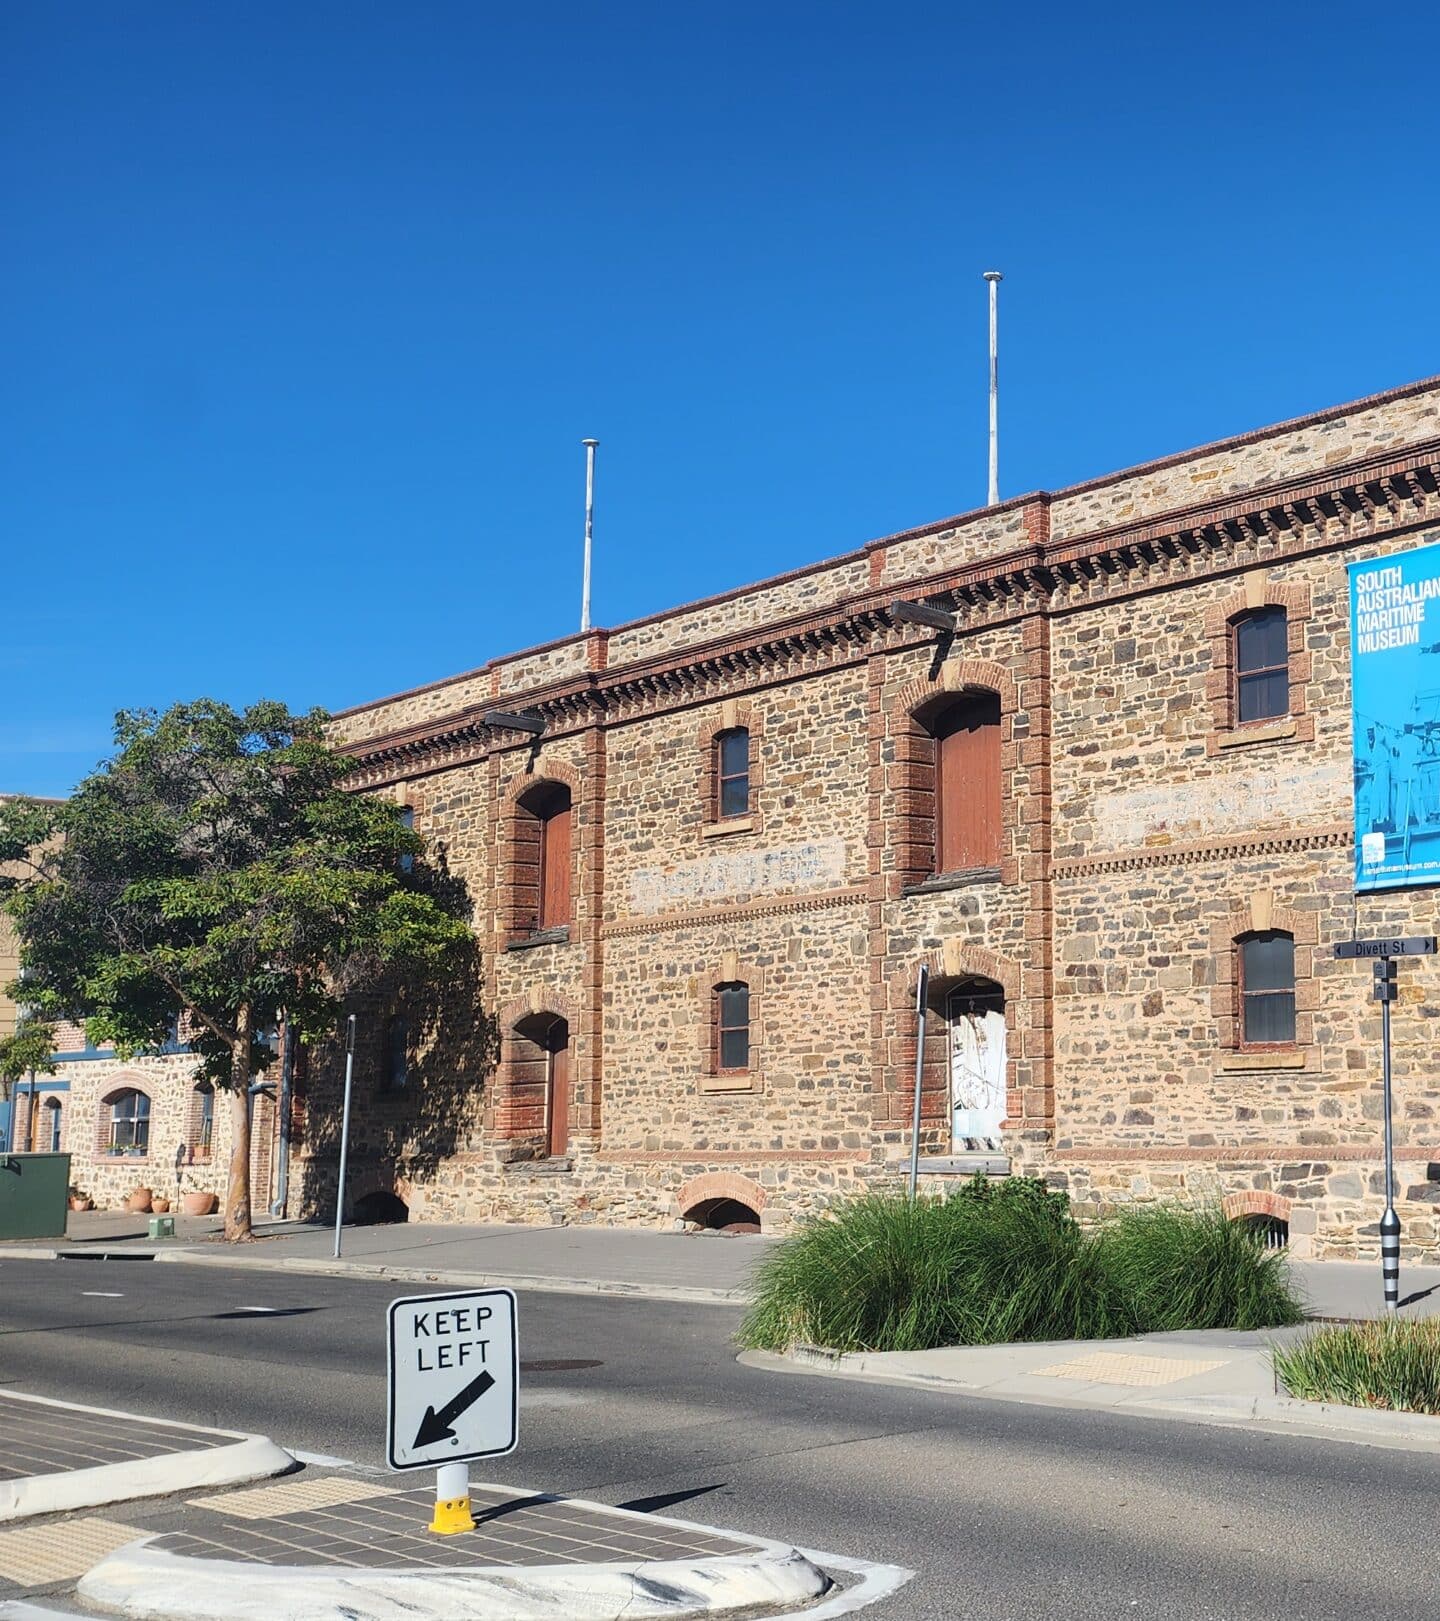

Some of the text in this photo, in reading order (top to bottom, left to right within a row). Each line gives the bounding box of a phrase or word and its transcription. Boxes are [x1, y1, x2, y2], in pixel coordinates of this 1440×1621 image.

[1356, 565, 1402, 594] SOUTH
[1357, 601, 1425, 634] MARITIME
[1357, 623, 1419, 655] MUSEUM
[1356, 941, 1405, 956] Divett St
[414, 1306, 493, 1338] KEEP
[417, 1339, 491, 1372] LEFT
